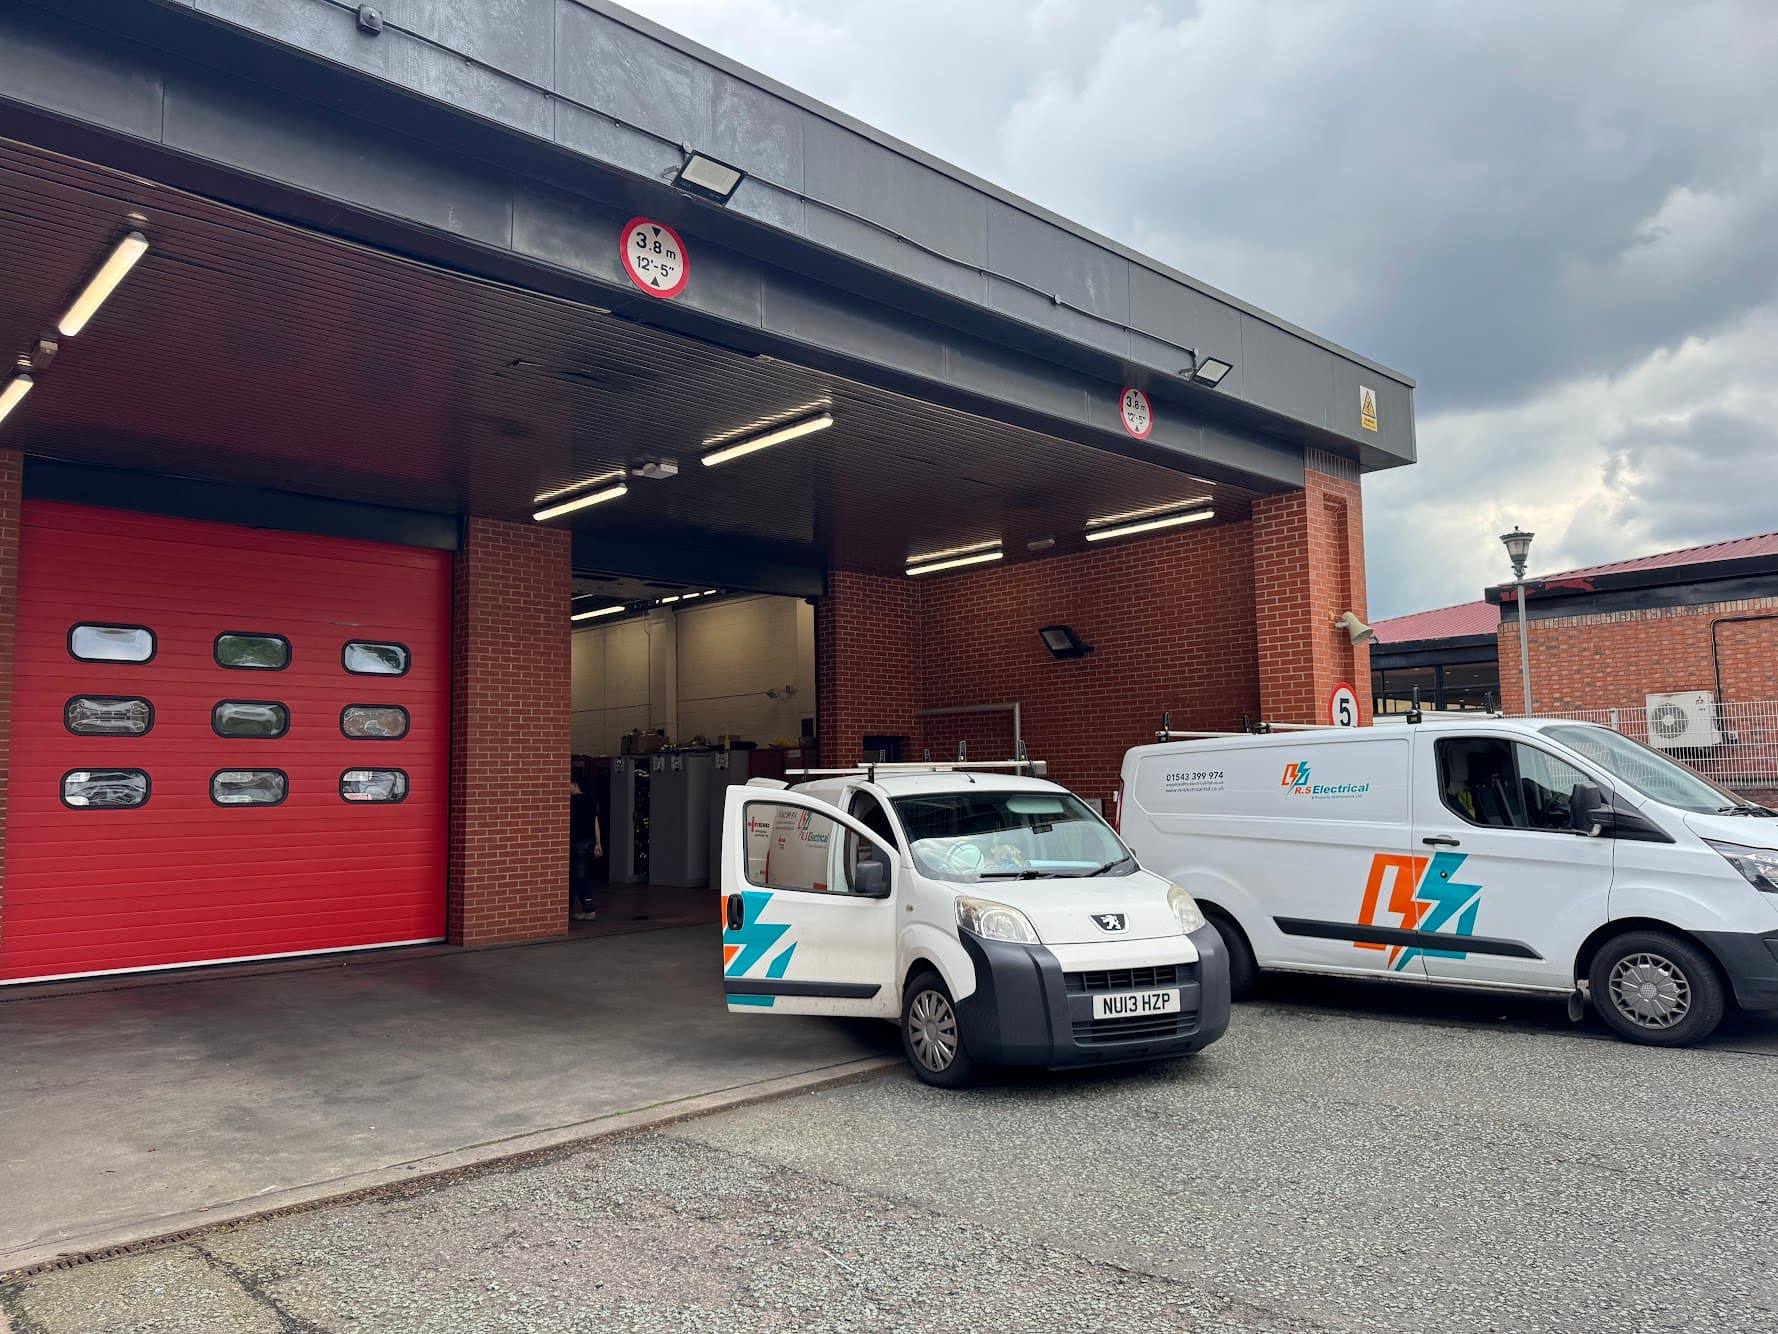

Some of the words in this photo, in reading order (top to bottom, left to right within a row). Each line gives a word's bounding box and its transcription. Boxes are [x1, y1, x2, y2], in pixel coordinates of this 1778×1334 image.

[636, 232, 662, 254] 3.8
[666, 249, 676, 260] m
[1126, 396, 1139, 409] 3.8
[1339, 698, 1351, 726] 5
[1166, 773, 1190, 782] 01543
[1191, 772, 1207, 781] 399
[1208, 771, 1224, 780] 974
[1294, 785, 1312, 795] R.S
[1312, 782, 1370, 794] Electrical
[1103, 996, 1138, 1015] NU13
[1142, 993, 1170, 1011] HZP
